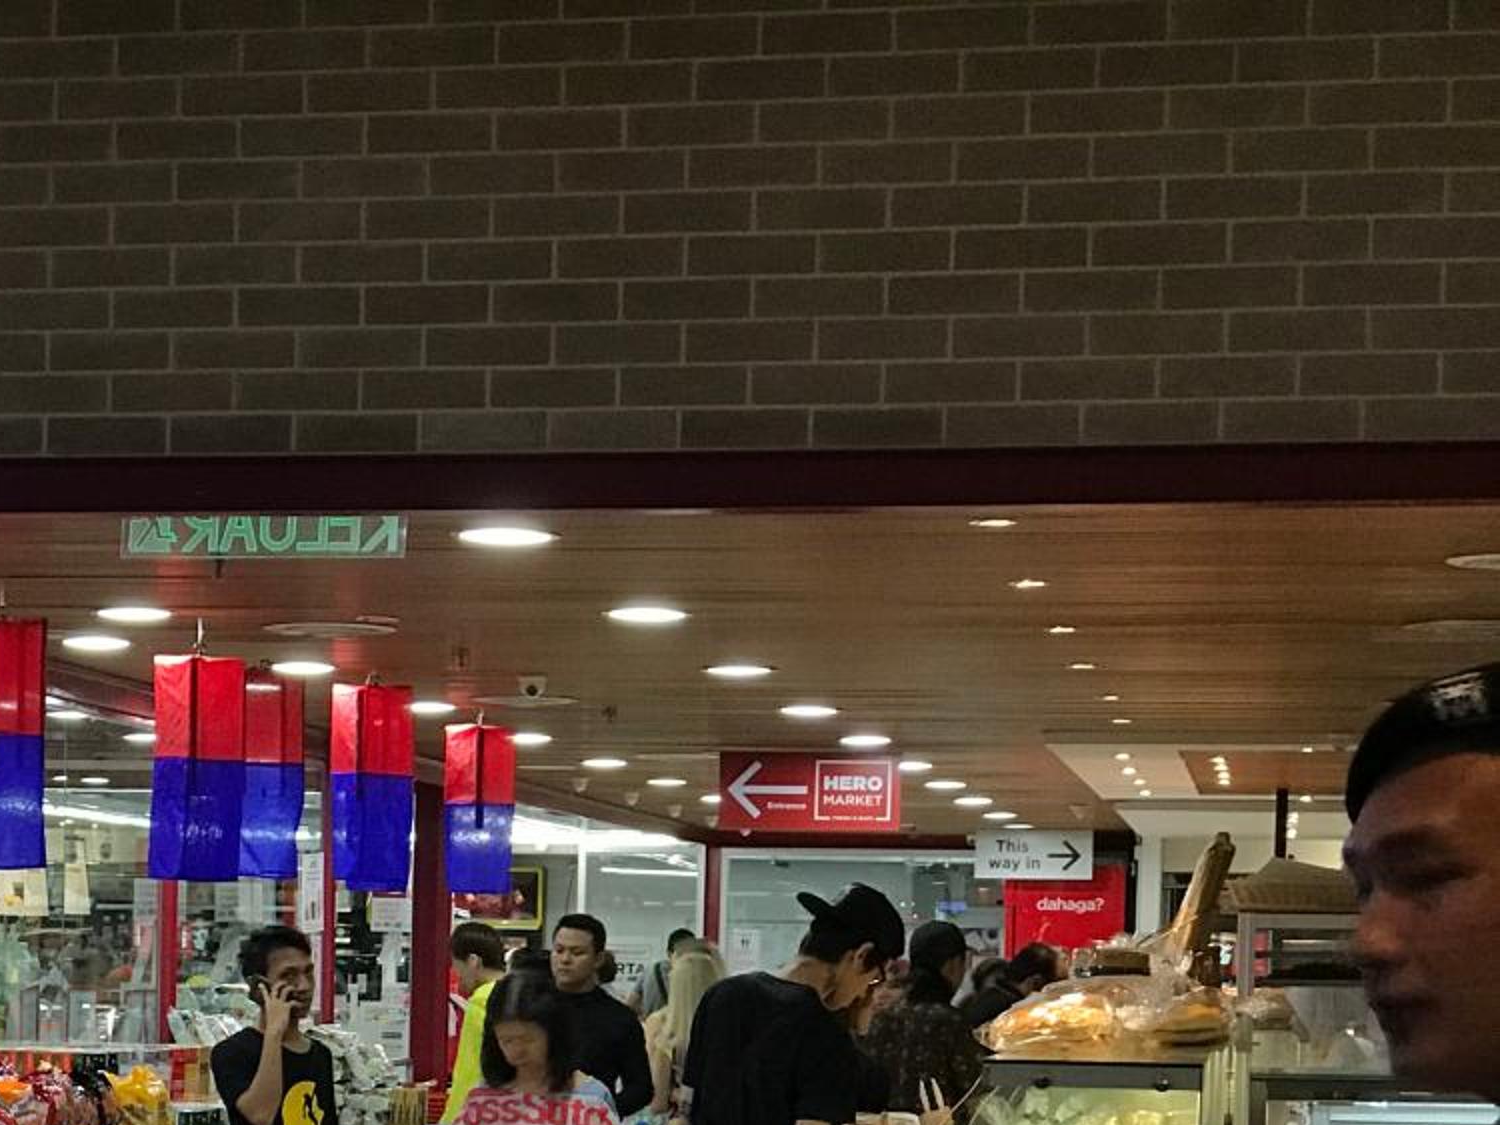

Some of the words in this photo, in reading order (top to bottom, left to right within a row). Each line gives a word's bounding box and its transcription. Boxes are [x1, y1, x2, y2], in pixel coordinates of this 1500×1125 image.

[823, 775, 883, 791] HERO
[823, 795, 883, 807] MARKET
[996, 838, 1029, 853] This
[988, 858, 1020, 871] way
[1026, 857, 1041, 869] in
[1036, 896, 1105, 914] dahaga?
